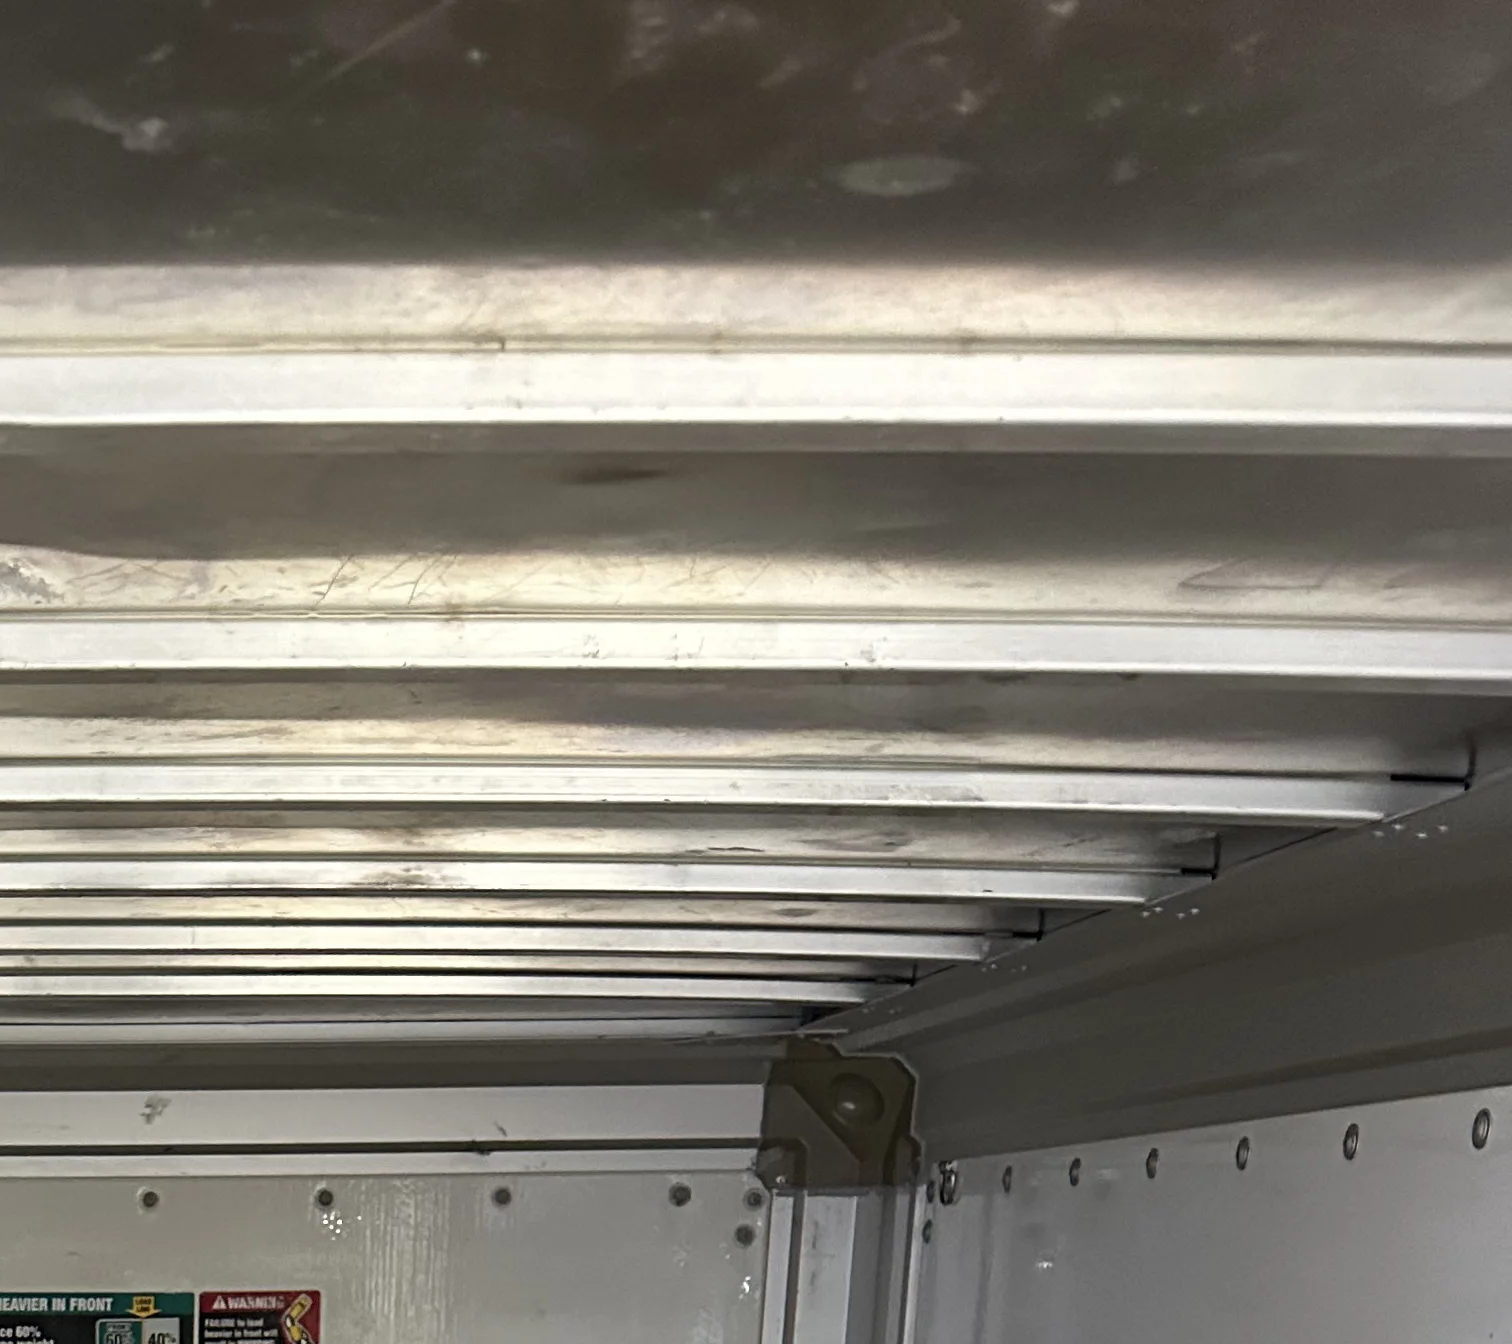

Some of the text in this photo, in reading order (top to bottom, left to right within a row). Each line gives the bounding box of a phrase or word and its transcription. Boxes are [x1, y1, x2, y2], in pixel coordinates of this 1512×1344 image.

[52, 1297, 66, 1311] IN
[70, 1297, 113, 1311] FRONT
[16, 1325, 41, 1337] 60%
